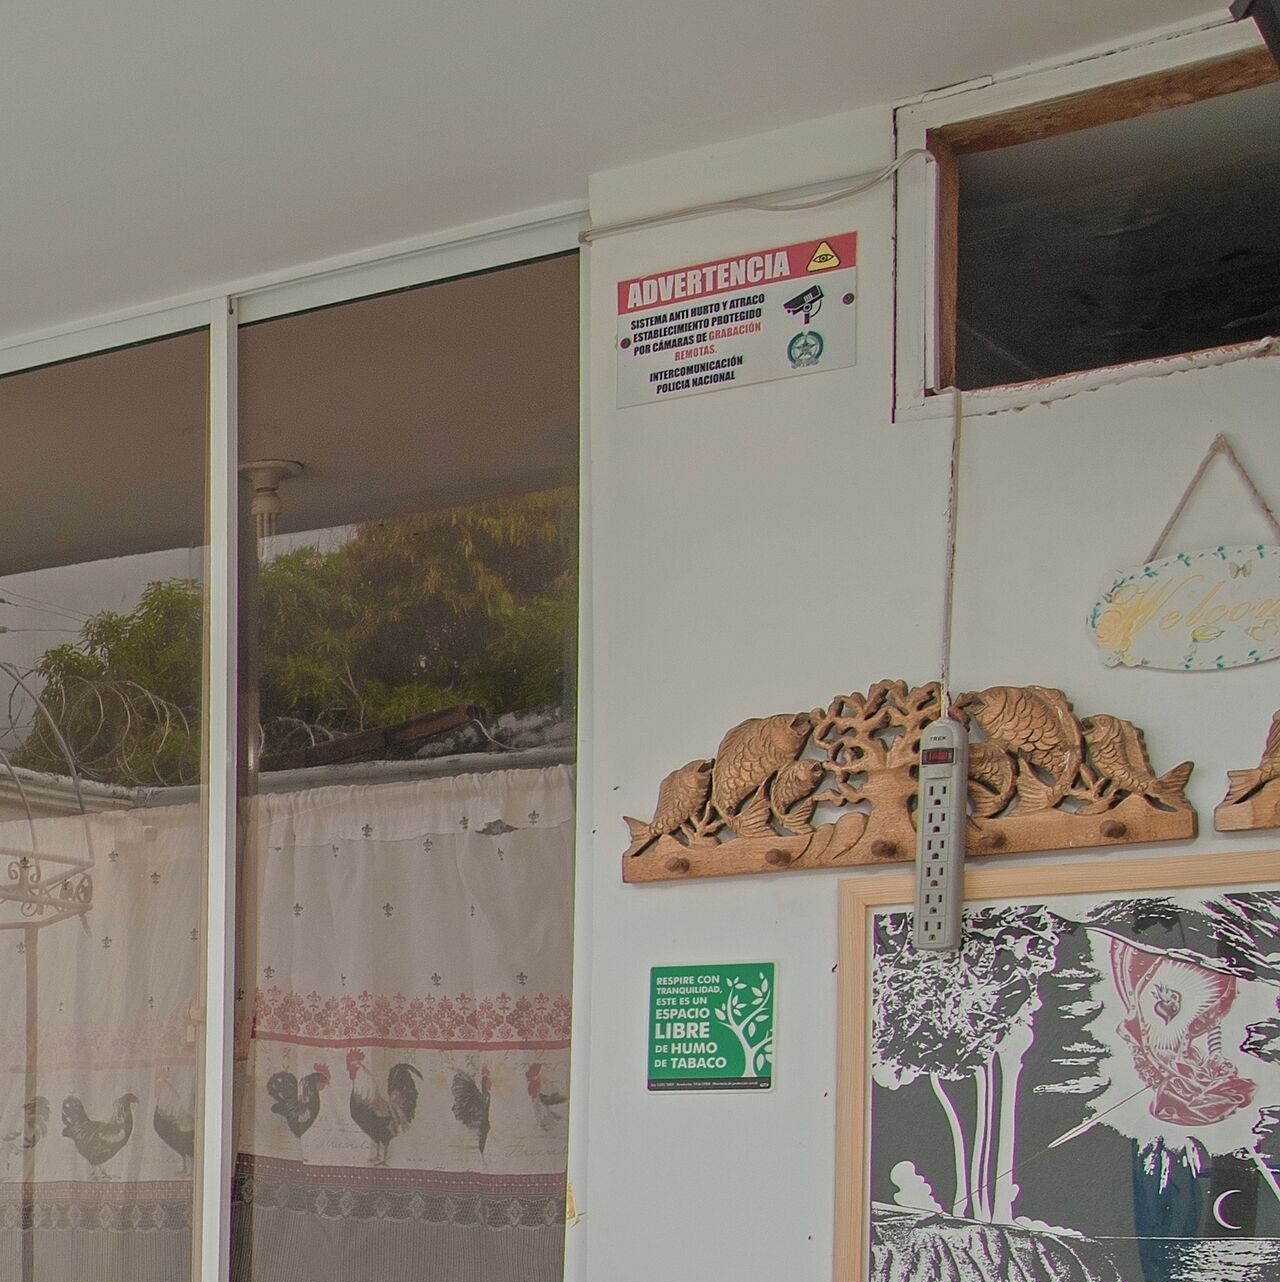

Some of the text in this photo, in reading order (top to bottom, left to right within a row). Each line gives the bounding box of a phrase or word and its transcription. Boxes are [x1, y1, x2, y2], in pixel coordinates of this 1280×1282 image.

[627, 251, 790, 309] ADVERTENCIA
[631, 293, 765, 330] SISTEMA ANTI HURTO Y ATRACO
[633, 308, 762, 343] ESTABLECIMIENTO PROTEGIDO
[634, 322, 762, 356] POR CÁMARAS DE GRABACIÓN
[674, 344, 717, 361] REMOTAS.
[650, 355, 743, 382] INTERCOMUNICACIÓN
[656, 371, 736, 394] POLICIA NACIONAL
[656, 975, 720, 985] RESPIRE CON
[656, 985, 723, 995] TRANQUILIDAD,
[656, 997, 707, 1006] ESTE ES UN
[655, 1008, 710, 1019] ESPACIO
[655, 1022, 710, 1039] LIBRE
[655, 1042, 718, 1054] DE HUMO
[654, 1057, 727, 1068] DE TABACO
